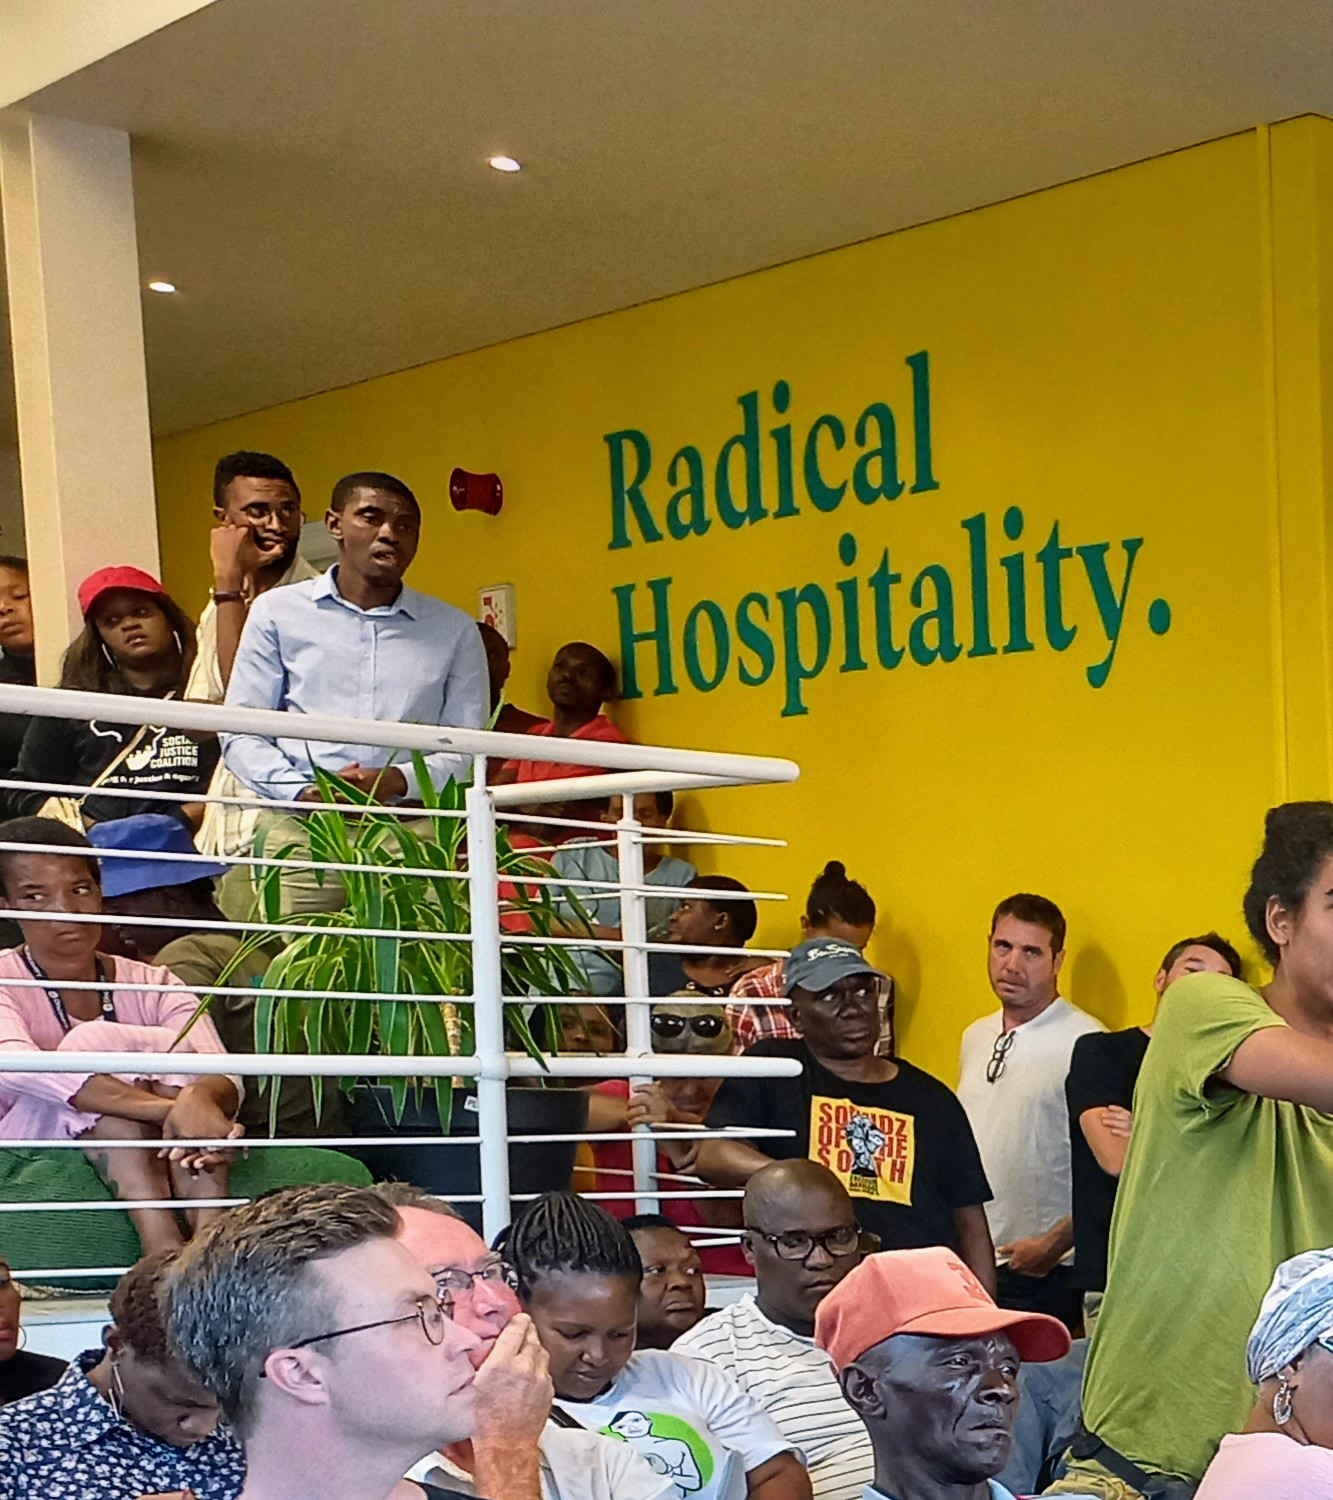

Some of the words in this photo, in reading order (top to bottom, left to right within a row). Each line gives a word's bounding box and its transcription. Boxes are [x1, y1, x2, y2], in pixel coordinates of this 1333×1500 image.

[604, 350, 940, 550] Radical
[612, 506, 1172, 718] Hospitality.
[150, 757, 199, 769] COALITION
[160, 745, 199, 758] JUSTICE
